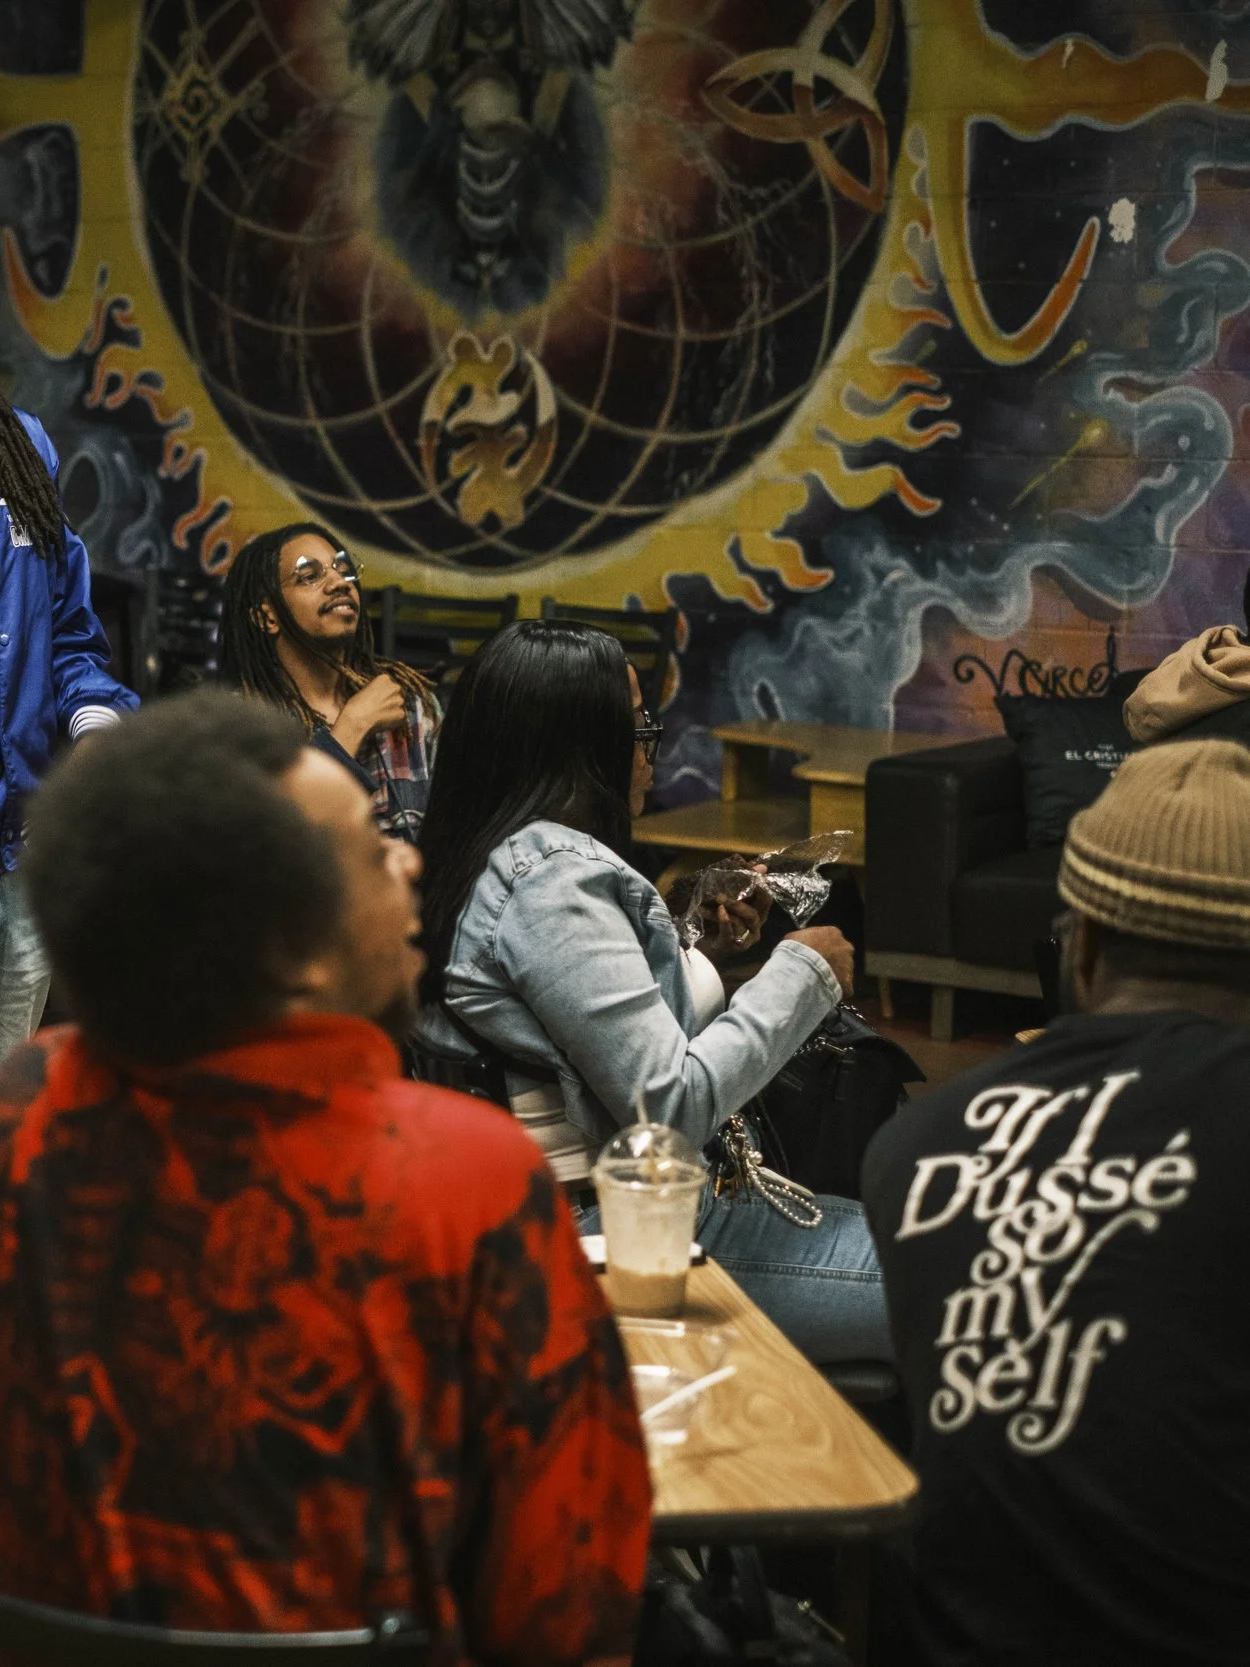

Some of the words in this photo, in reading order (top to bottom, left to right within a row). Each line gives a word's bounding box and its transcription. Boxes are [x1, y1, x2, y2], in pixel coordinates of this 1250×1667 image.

[963, 1084, 1091, 1181] If
[1055, 1067, 1142, 1167] I
[894, 1127, 1199, 1242] Dussé
[933, 1209, 1161, 1353] my
[969, 1202, 1087, 1286] so
[928, 1316, 1129, 1455] self
